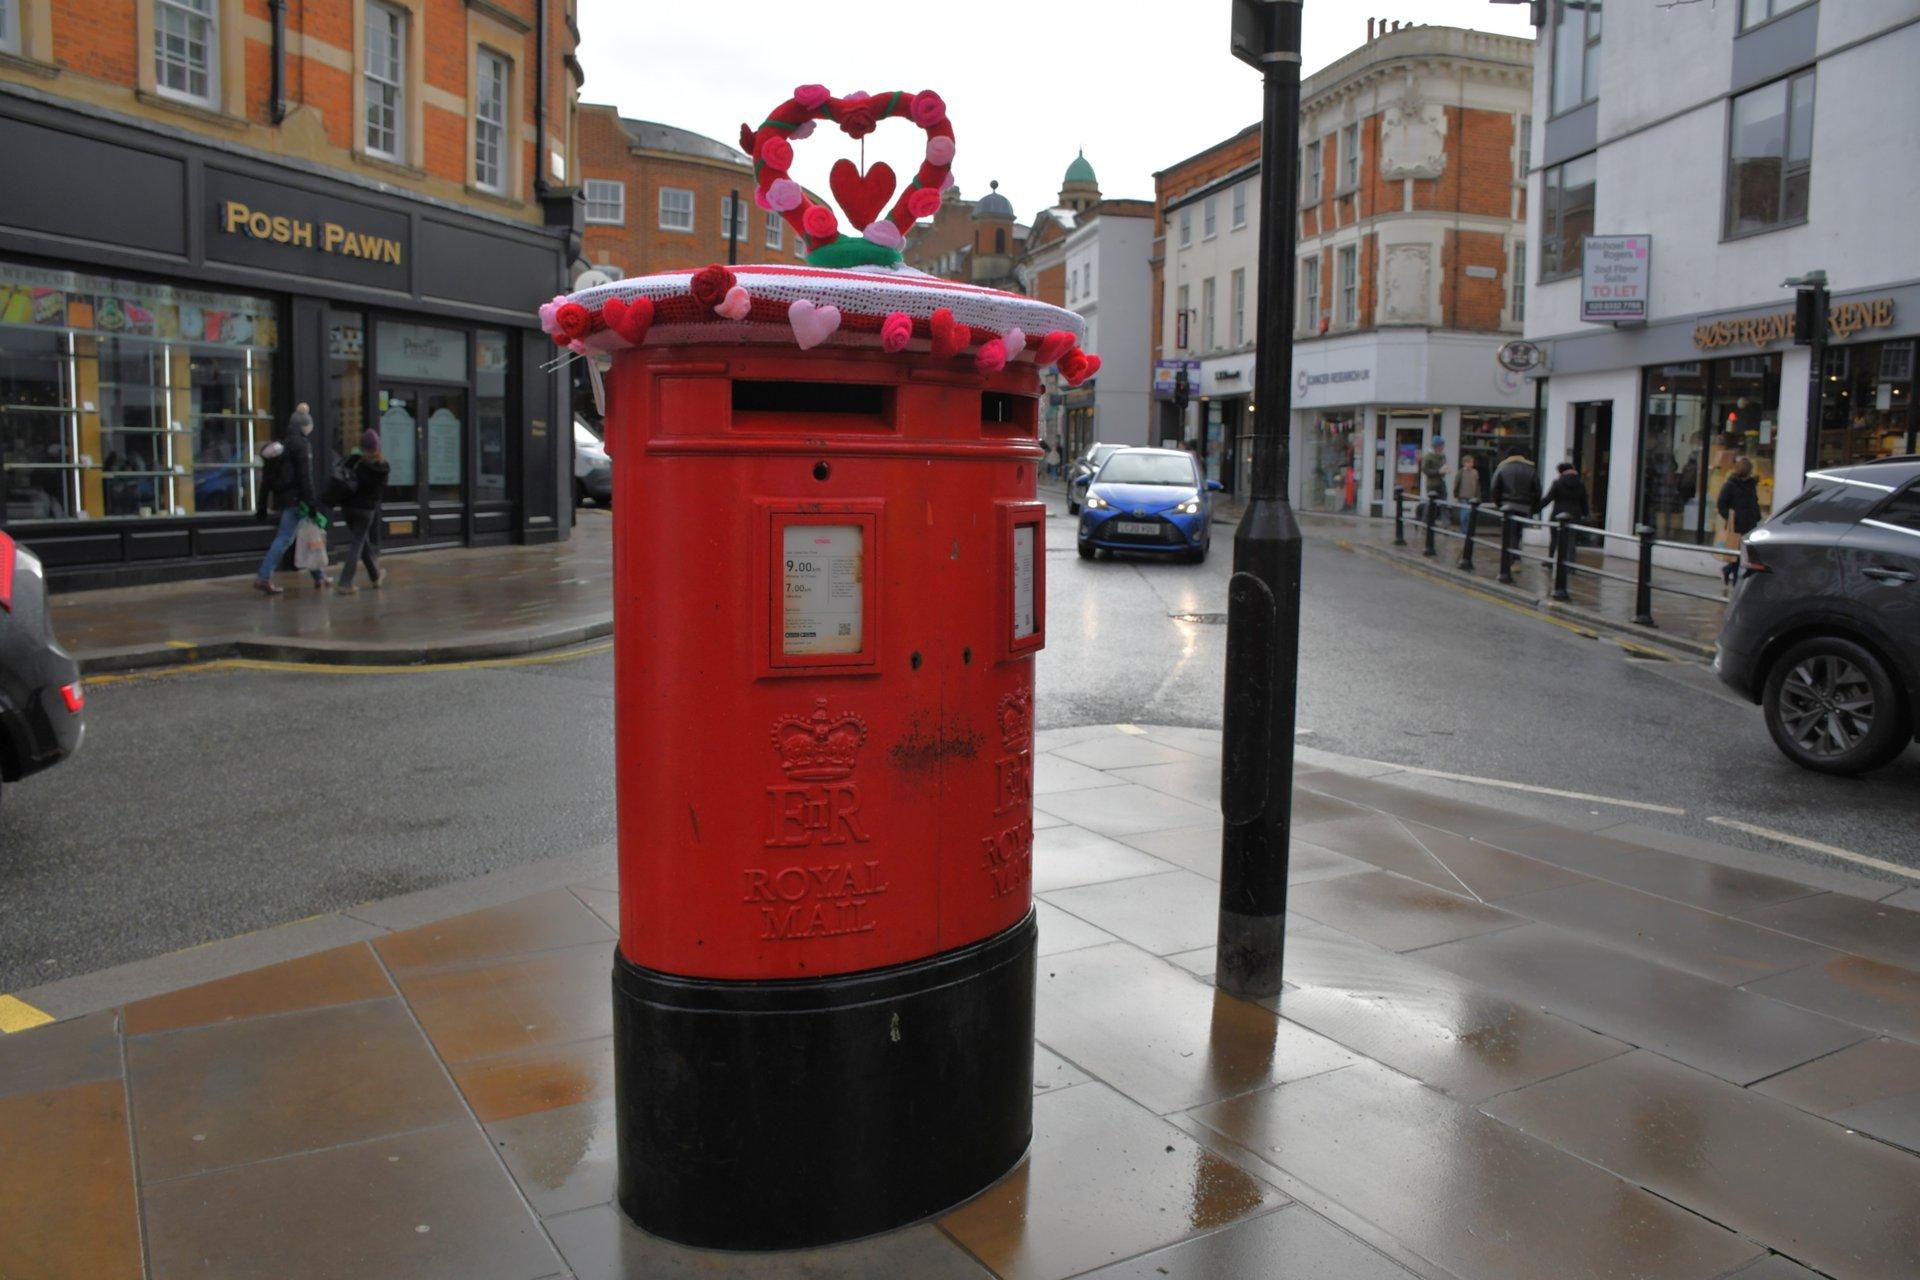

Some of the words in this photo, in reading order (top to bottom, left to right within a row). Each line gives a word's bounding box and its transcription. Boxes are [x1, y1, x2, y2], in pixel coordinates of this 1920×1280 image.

[226, 200, 312, 247] POSH
[324, 222, 401, 264] PAWN
[1592, 285, 1611, 298] TO
[1614, 284, 1639, 297] LET
[1827, 298, 1895, 340] RENE
[744, 860, 889, 903] ROYAL
[761, 900, 876, 940] MAIL
